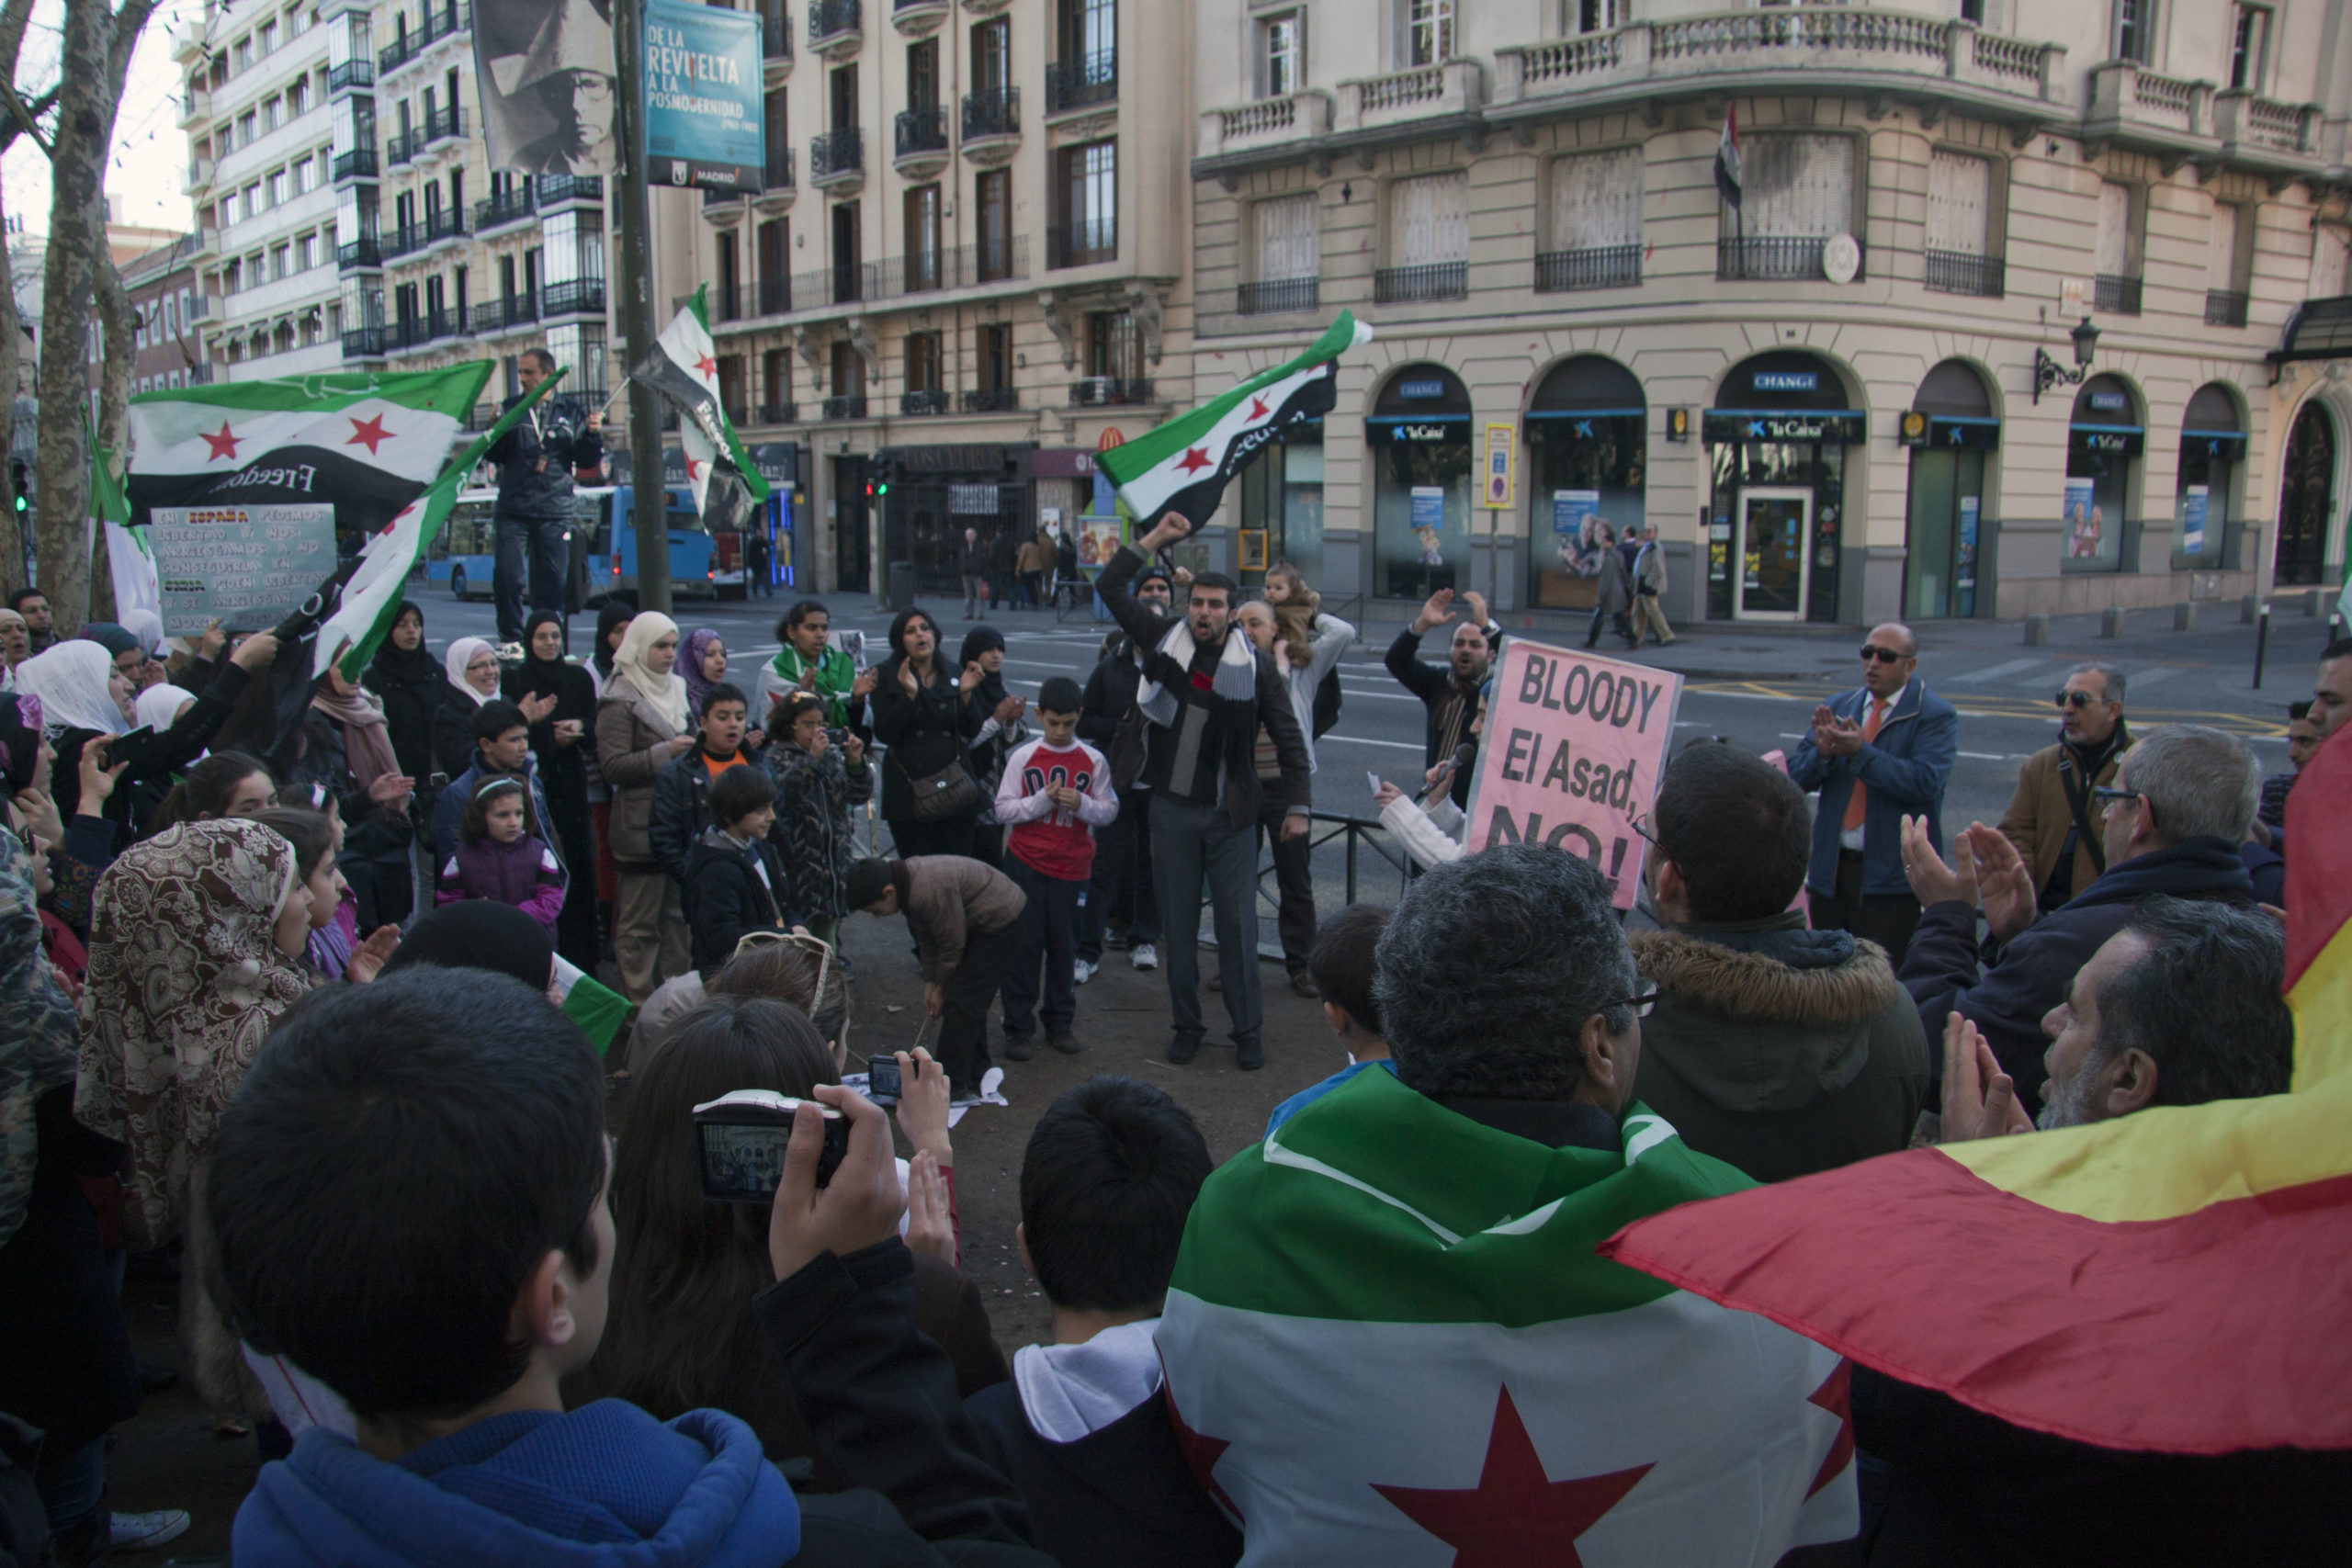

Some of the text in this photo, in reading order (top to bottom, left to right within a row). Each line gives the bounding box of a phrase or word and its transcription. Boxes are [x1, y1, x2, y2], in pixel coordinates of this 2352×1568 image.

[648, 25, 684, 48] DE LA
[648, 47, 739, 85] REVUELTA
[648, 74, 678, 92] A LA
[1401, 383, 1442, 395] CHANGE
[1754, 374, 1816, 389] CHANGE
[189, 508, 249, 524] ESPAÑA
[158, 527, 227, 542] LIBERTAD
[266, 526, 300, 540] NOS
[1519, 653, 1663, 734] BLOODY
[1542, 739, 1637, 823] Asad,
